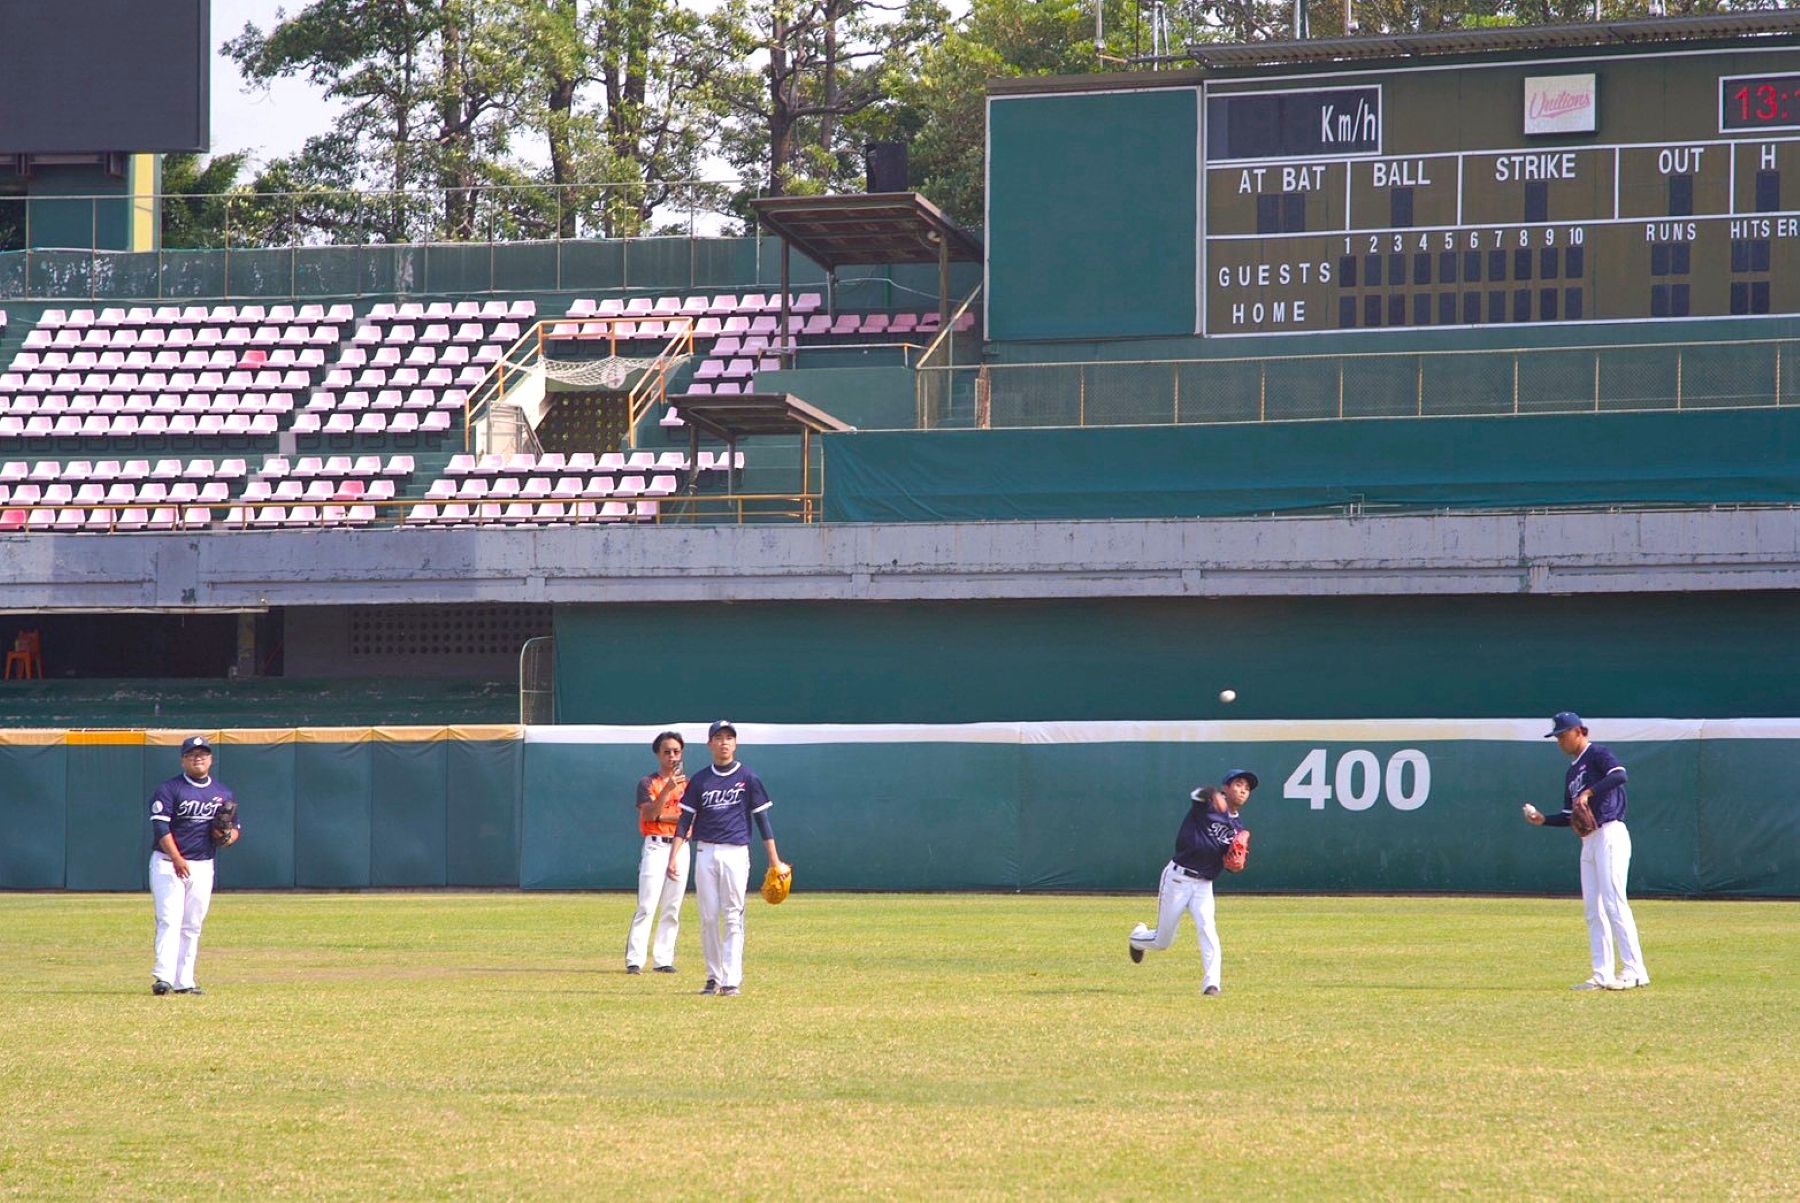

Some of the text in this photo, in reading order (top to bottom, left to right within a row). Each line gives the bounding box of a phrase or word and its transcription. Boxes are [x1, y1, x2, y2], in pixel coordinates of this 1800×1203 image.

[1321, 98, 1376, 142] Km/h
[1495, 154, 1576, 181] STRIKE
[1658, 148, 1704, 173] OUT
[1761, 145, 1776, 170] H
[1239, 166, 1325, 193] AT BAT
[1373, 161, 1431, 187] BALL
[1344, 227, 1583, 254] 1 2 3 4 5 6 7 8 9 10
[1646, 223, 1696, 241] RUNS
[1731, 220, 1770, 239] HITS
[1218, 262, 1331, 287] GUESTS
[1232, 301, 1305, 324] HOME
[1283, 749, 1431, 811] 400
